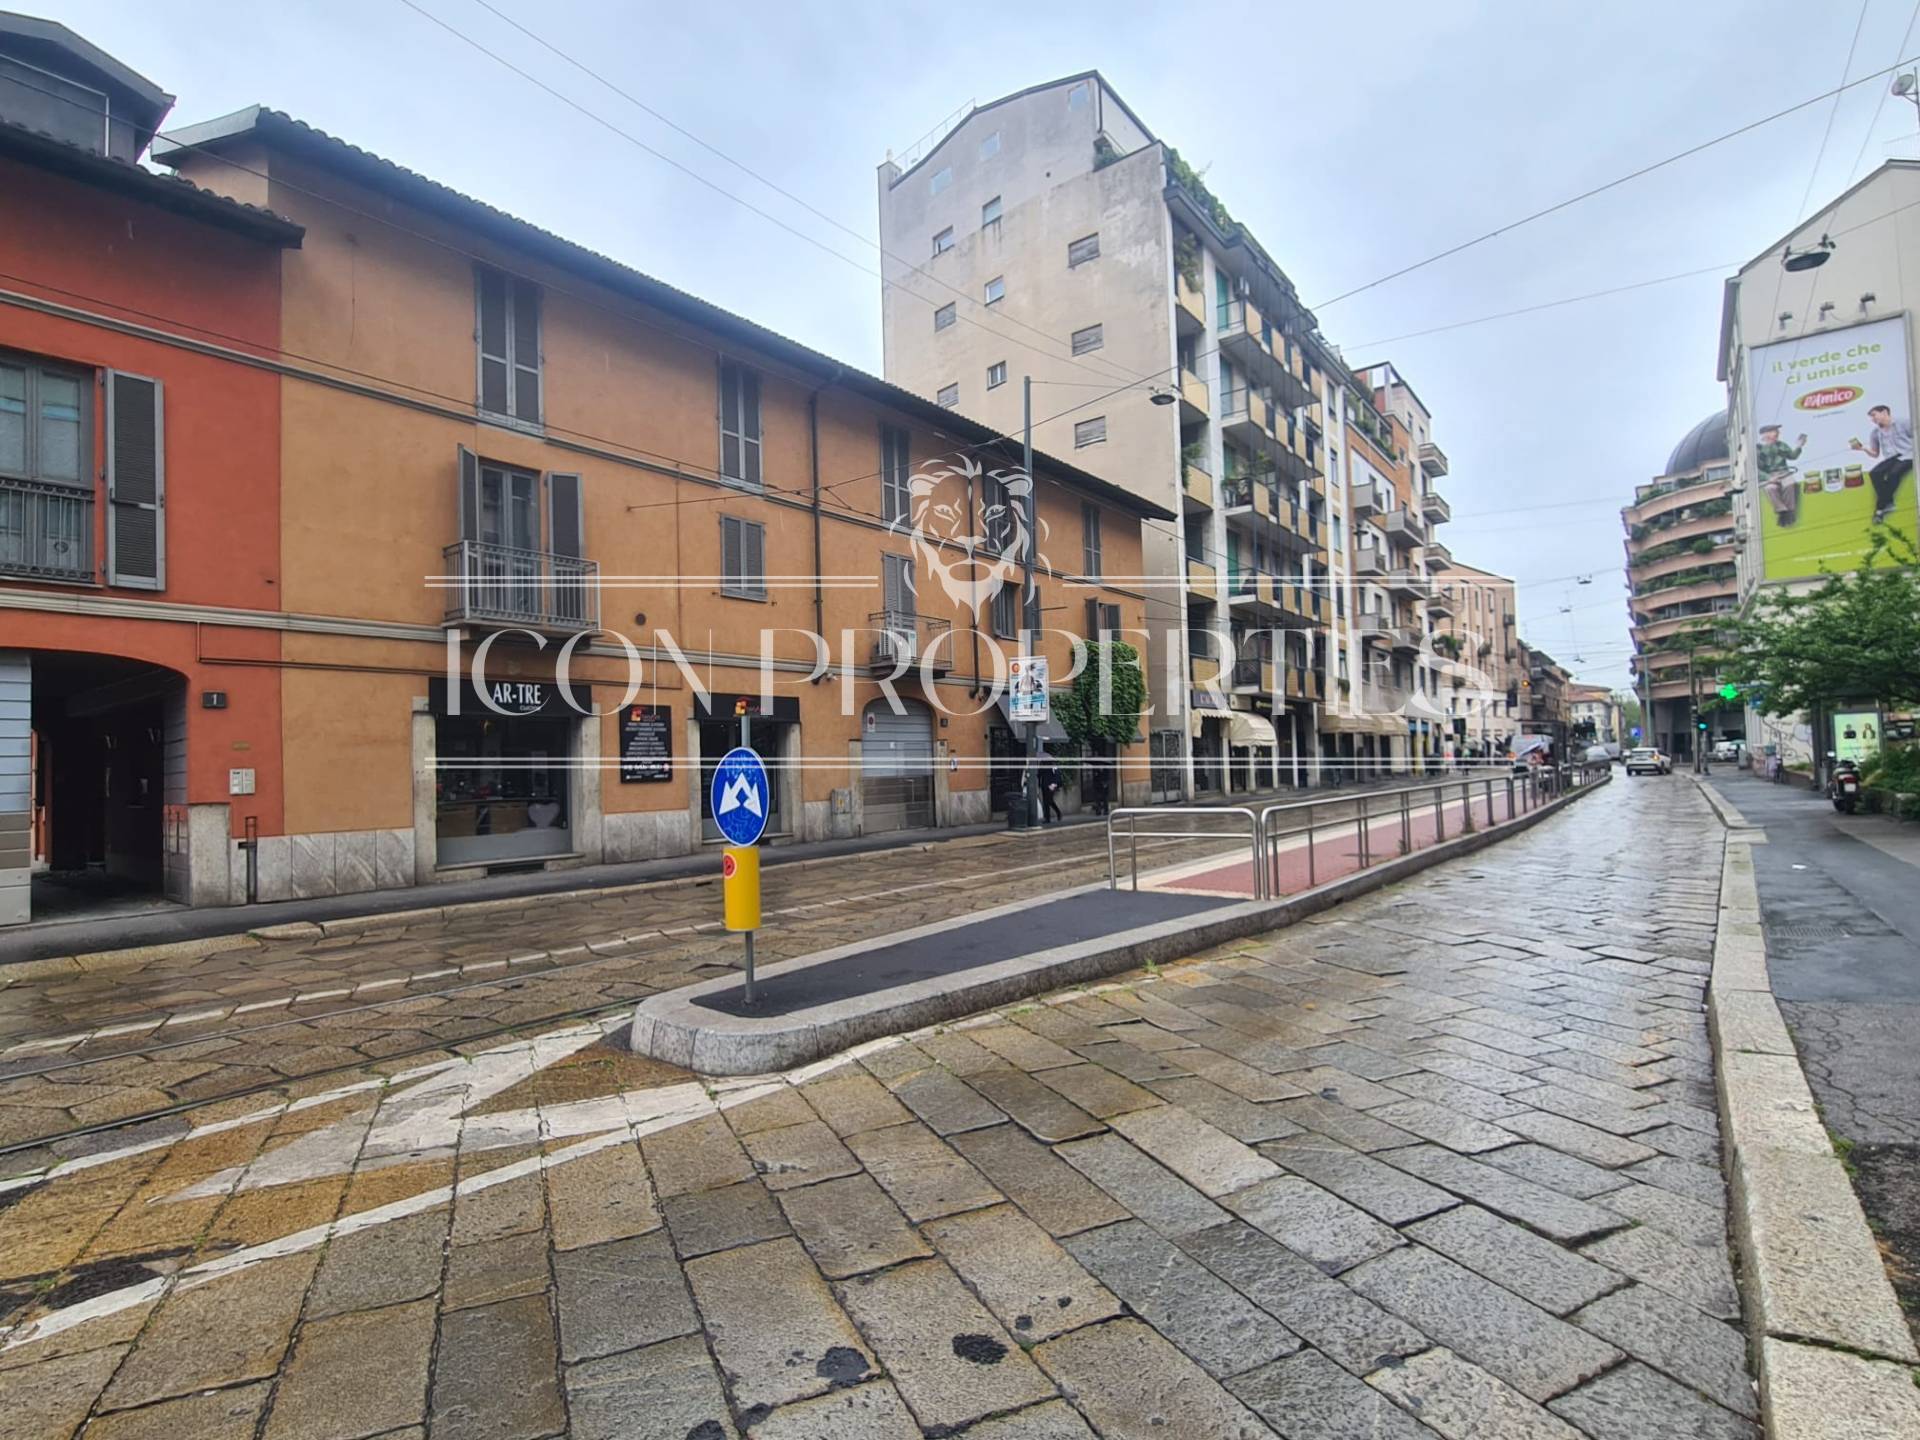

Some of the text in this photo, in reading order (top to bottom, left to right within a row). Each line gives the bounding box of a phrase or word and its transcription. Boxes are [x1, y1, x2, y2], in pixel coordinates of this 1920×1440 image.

[1772, 343, 1881, 373] il verde che
[1786, 361, 1869, 384] ci unisce
[493, 682, 542, 705] AR-TRE
